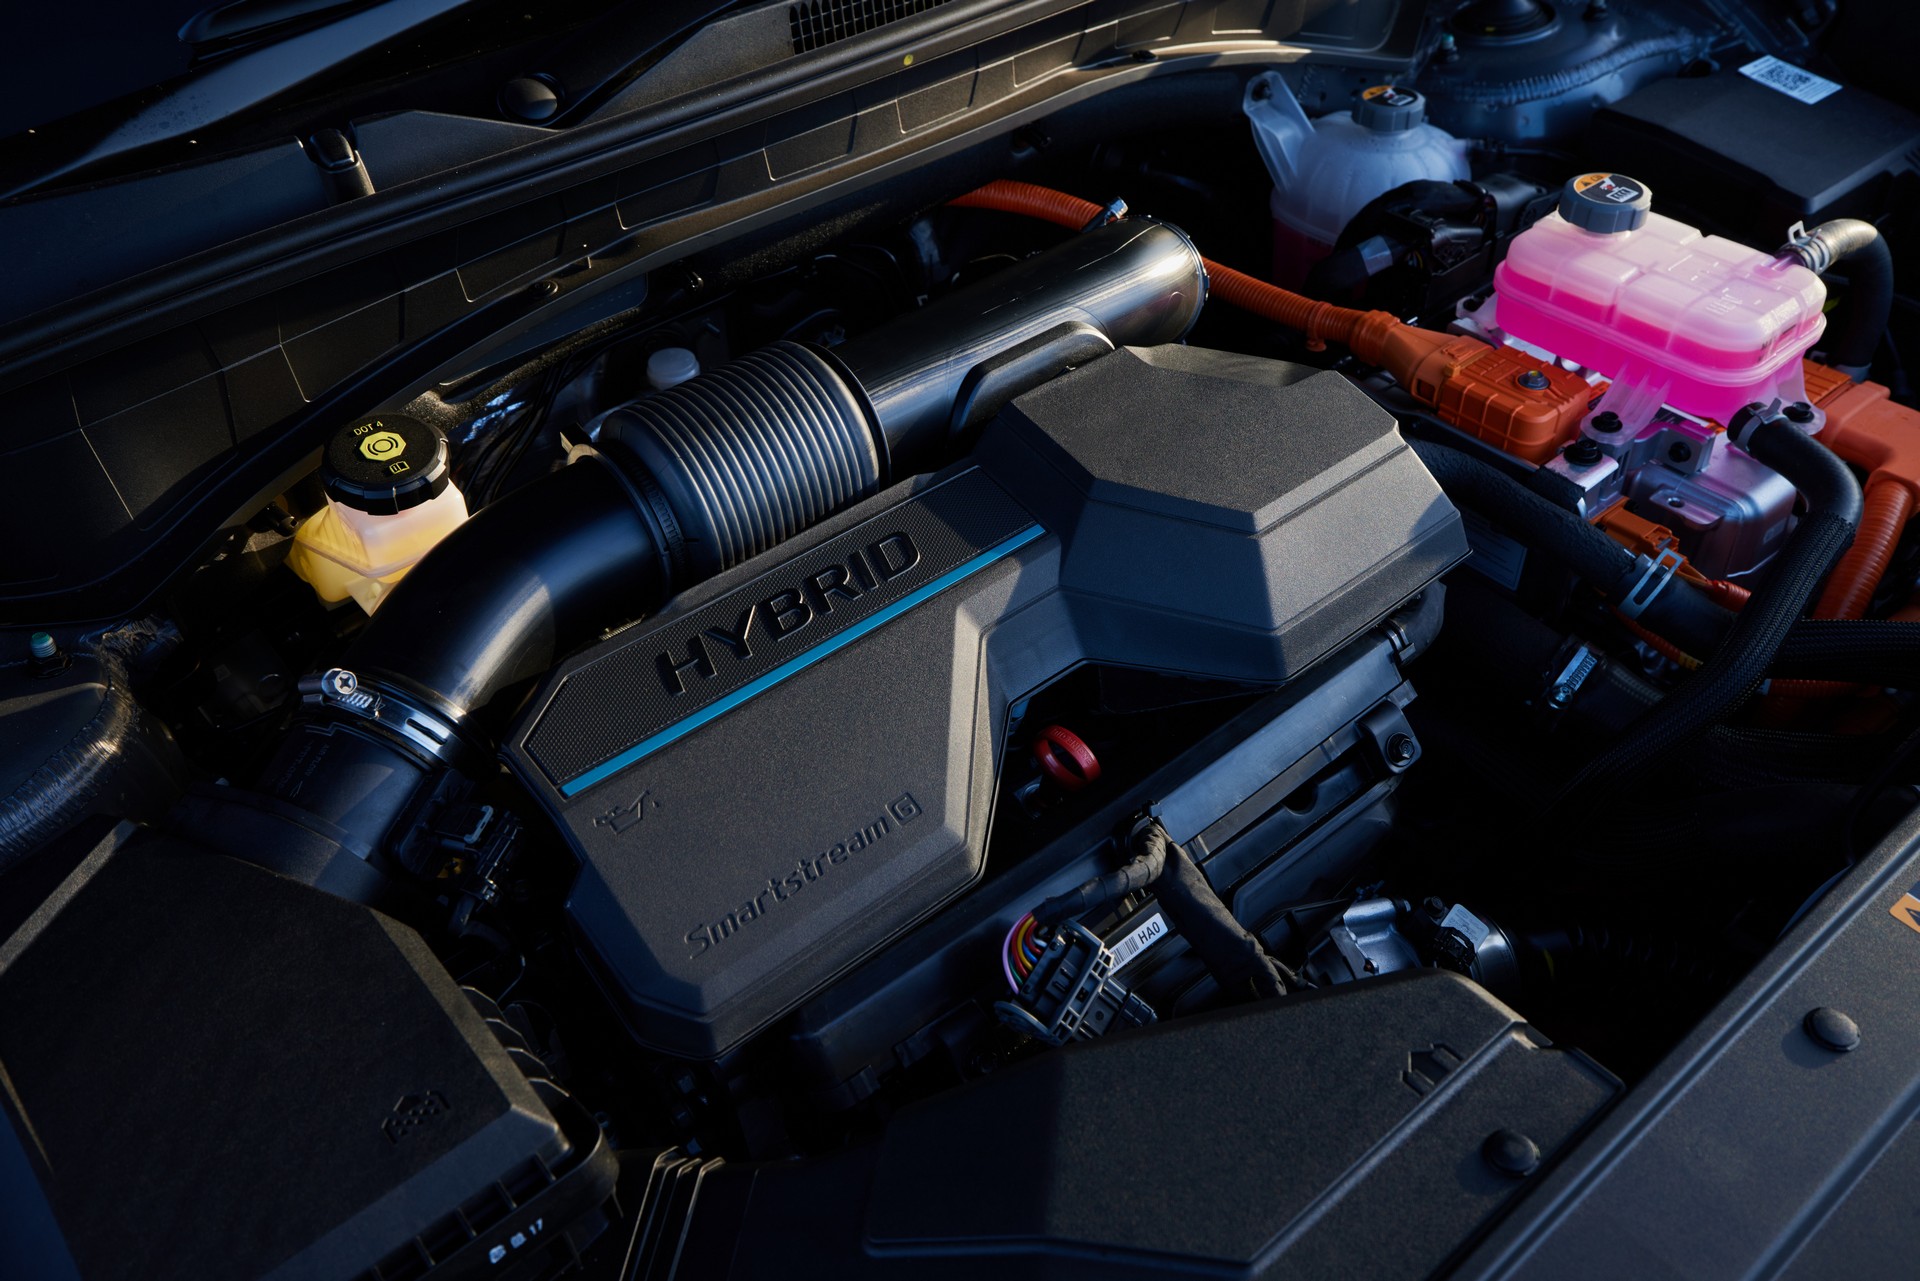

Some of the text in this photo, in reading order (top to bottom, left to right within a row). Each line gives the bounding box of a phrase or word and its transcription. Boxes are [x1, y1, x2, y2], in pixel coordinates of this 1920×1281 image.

[353, 420, 384, 436] DOT 4
[654, 531, 920, 696] HYBRID
[684, 795, 919, 960] Smartstream G
